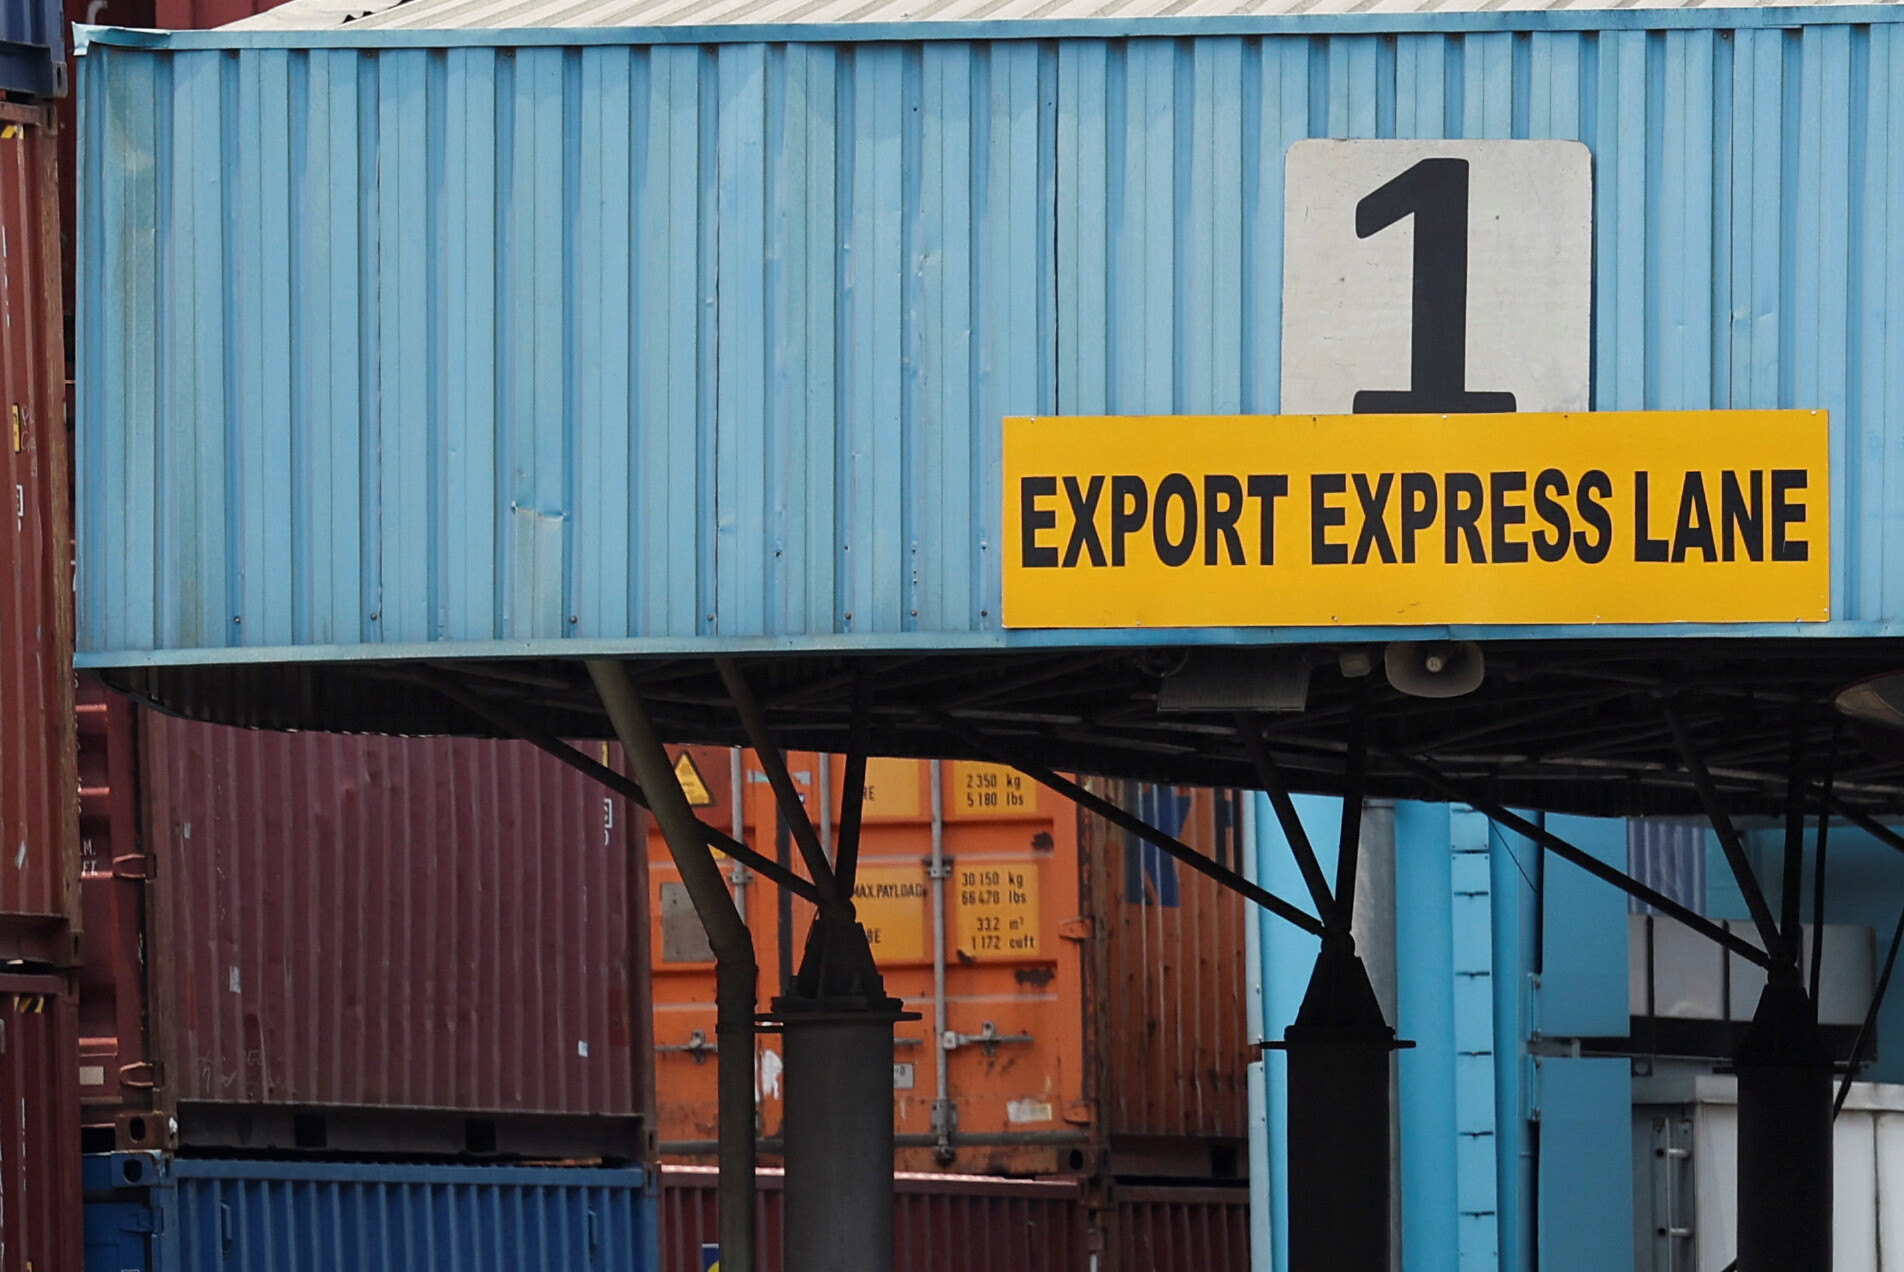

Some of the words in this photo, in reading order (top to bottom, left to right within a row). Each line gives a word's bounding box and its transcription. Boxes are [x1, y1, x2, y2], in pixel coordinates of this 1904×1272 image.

[1353, 157, 1517, 414] 1
[1020, 474, 1288, 569] EXPORT
[1311, 469, 1613, 566] EXPRESS
[1634, 469, 1810, 564] LANE
